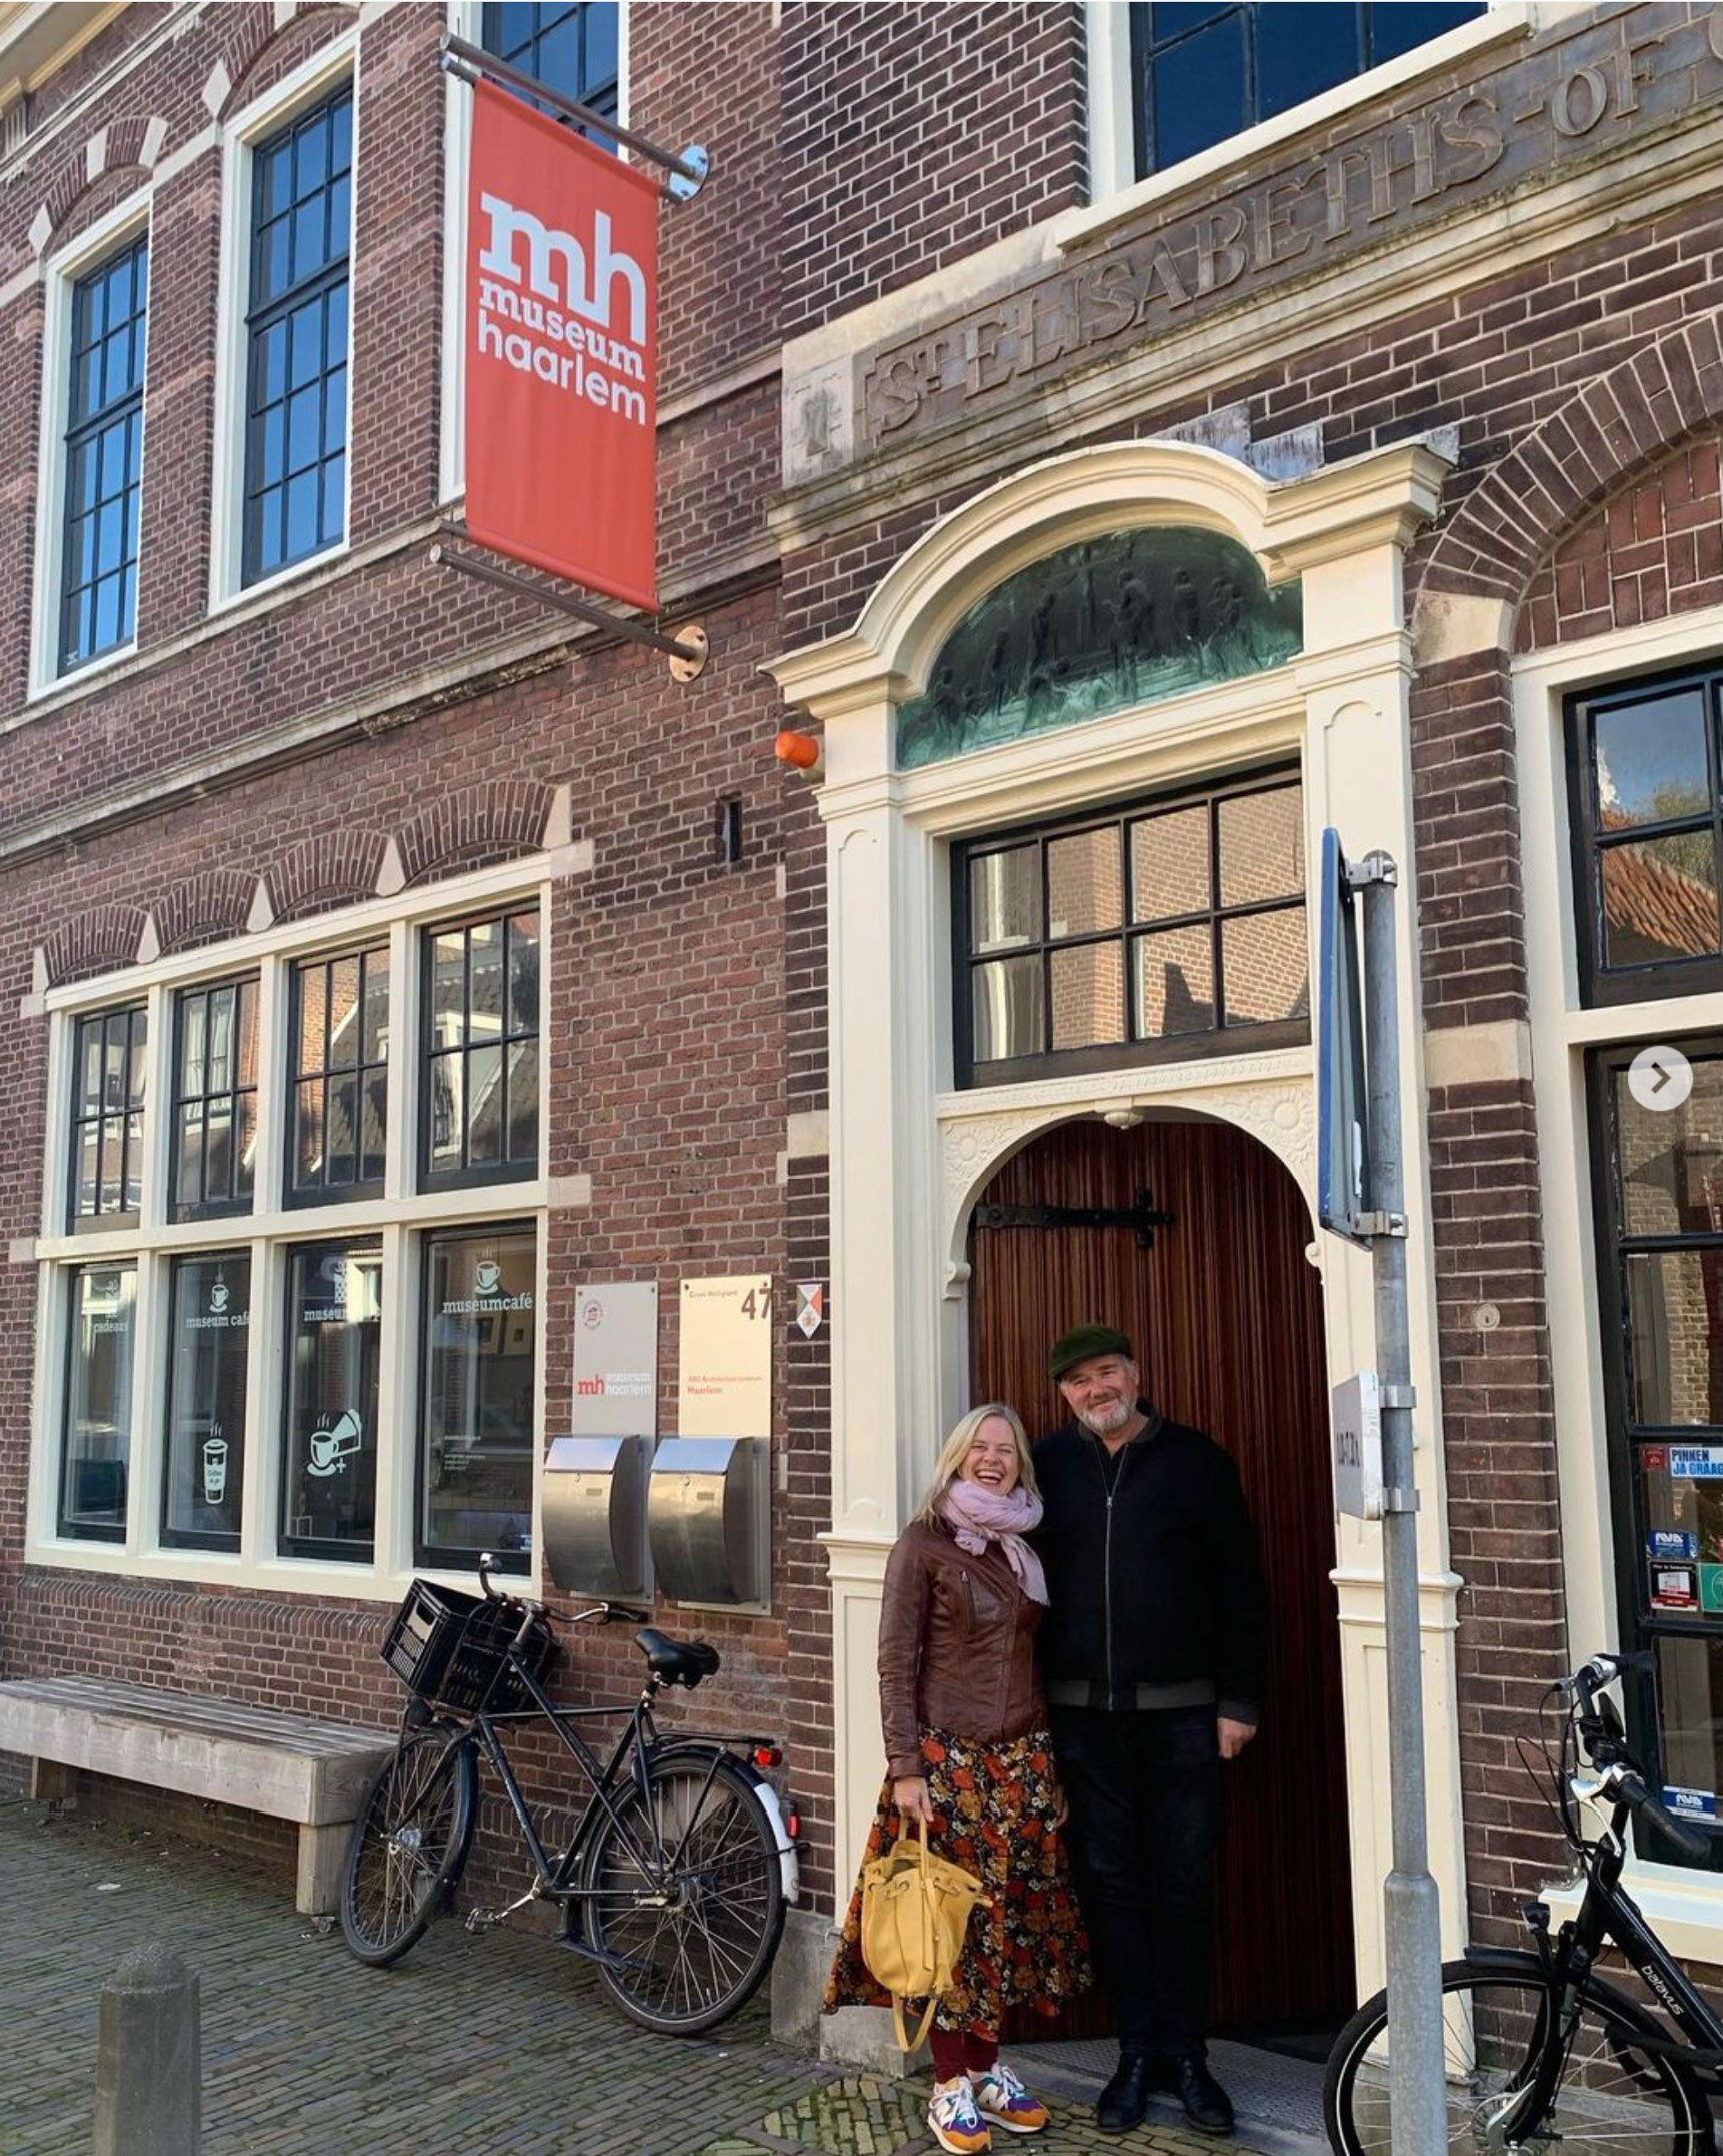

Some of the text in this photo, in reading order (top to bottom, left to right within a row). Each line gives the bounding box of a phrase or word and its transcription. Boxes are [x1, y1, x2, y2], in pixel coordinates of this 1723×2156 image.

[479, 190, 647, 346] mh
[479, 277, 646, 382] museum
[478, 309, 646, 426] haarlem
[442, 1292, 532, 1314] museumcafé
[742, 1288, 771, 1320] 47
[186, 1316, 228, 1329] museum
[578, 1373, 605, 1395] mh
[1671, 1449, 1709, 1462] PINKEN
[1672, 1462, 1687, 1475] JA
[1642, 1965, 1685, 2015] batavus
